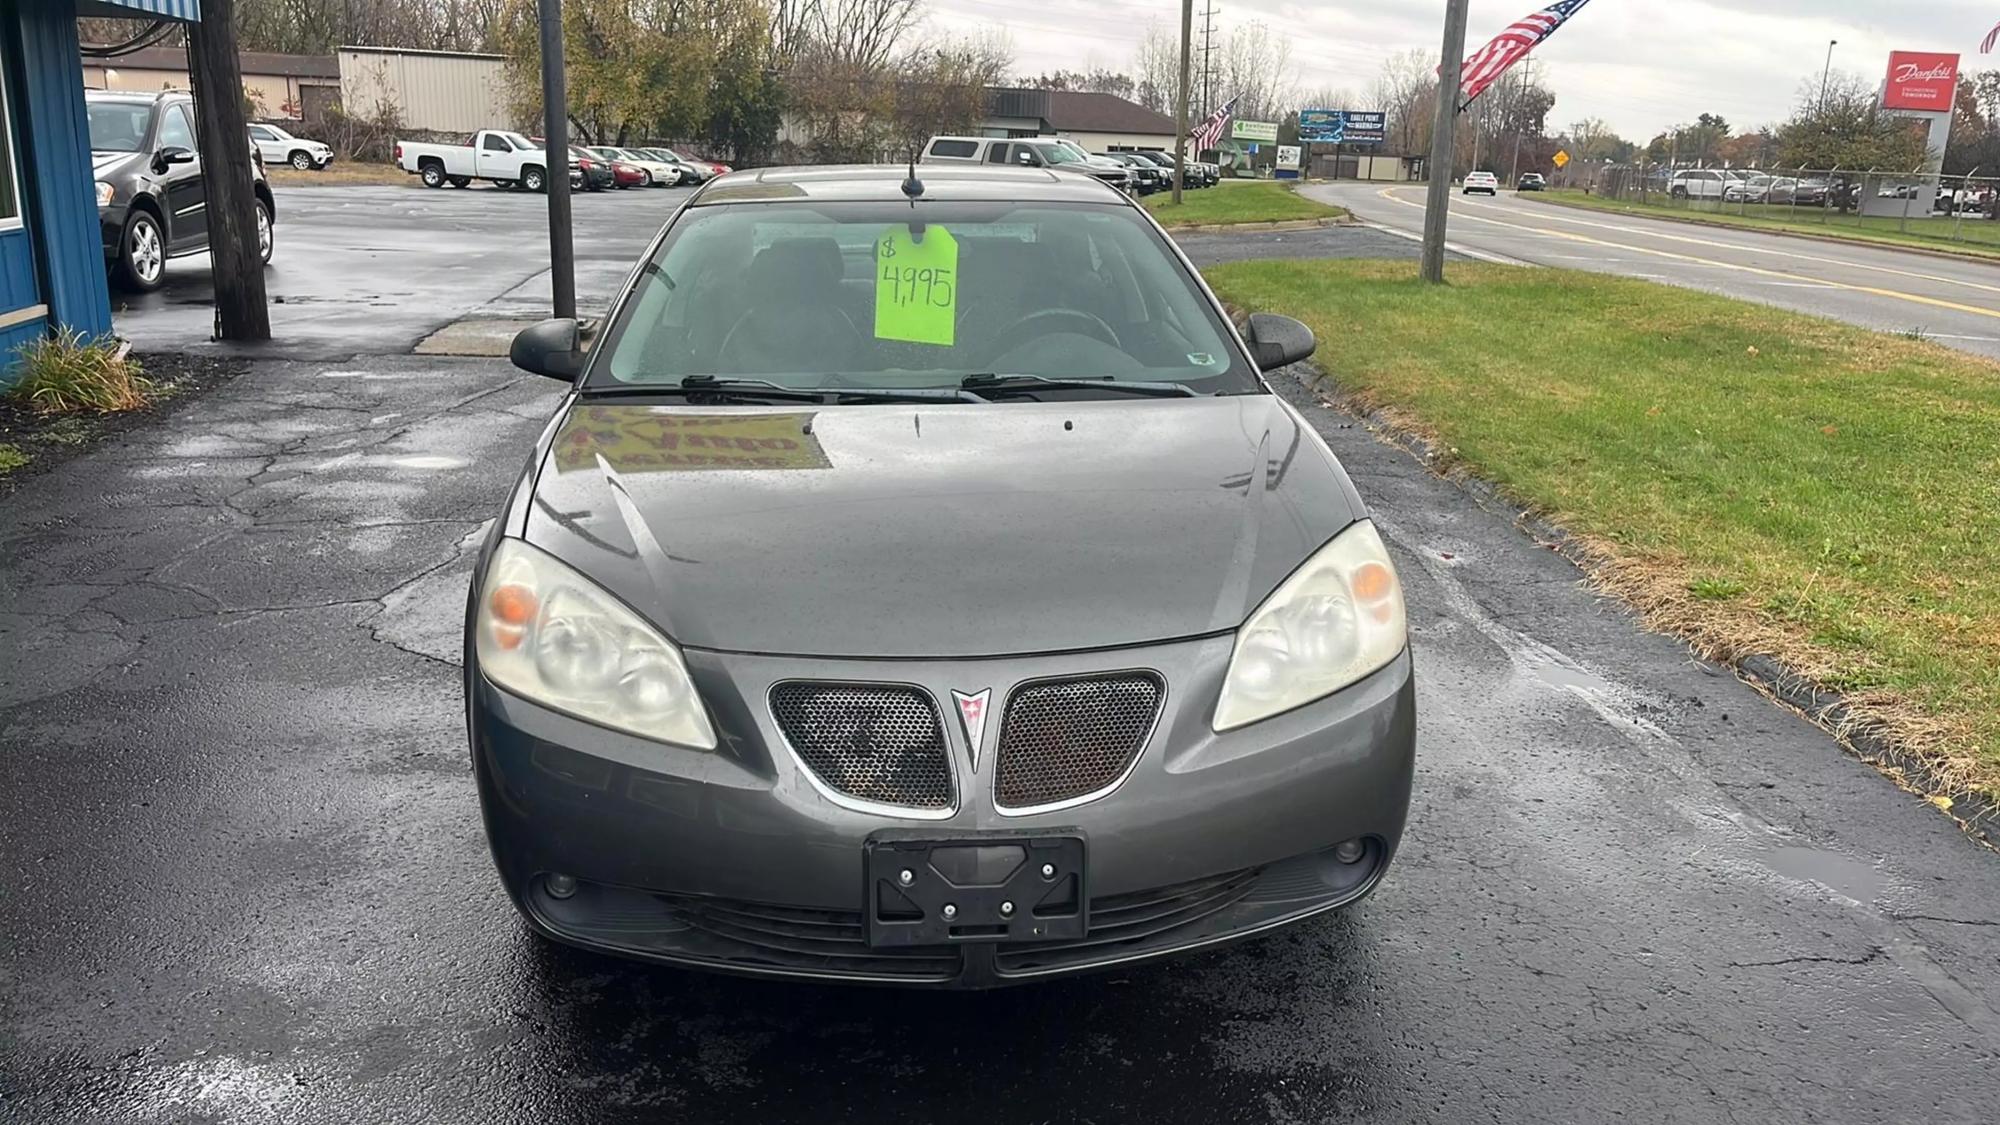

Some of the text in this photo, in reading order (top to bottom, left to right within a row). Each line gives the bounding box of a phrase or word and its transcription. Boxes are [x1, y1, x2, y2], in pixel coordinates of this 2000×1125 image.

[1895, 62, 1952, 83] Danfoss
[1350, 113, 1380, 122] EAGLE POINT
[881, 236, 896, 258] $
[883, 265, 952, 307] 4,995
